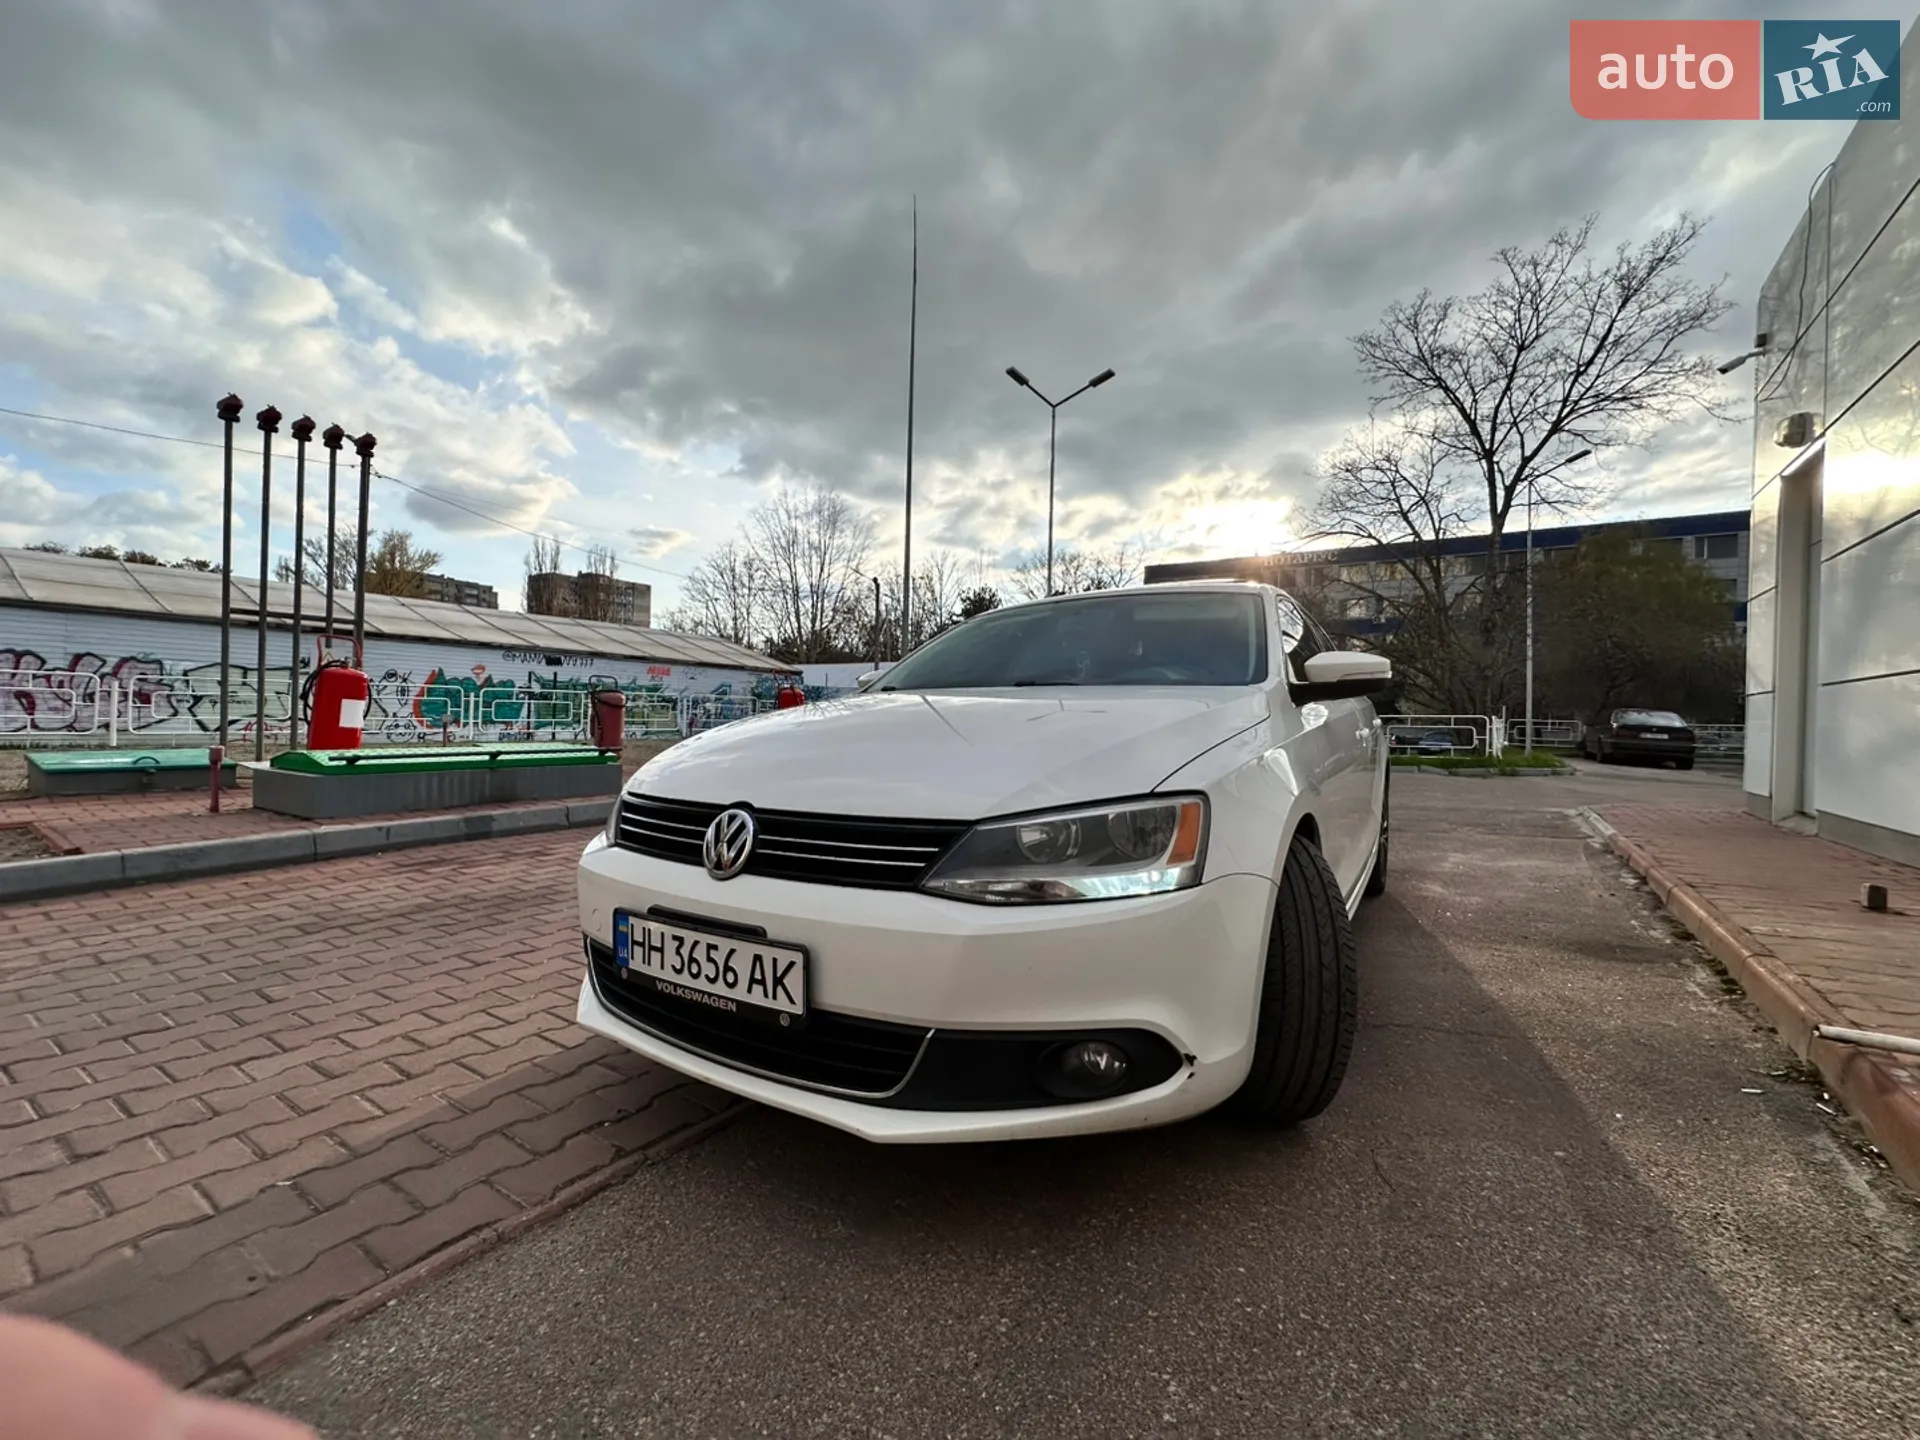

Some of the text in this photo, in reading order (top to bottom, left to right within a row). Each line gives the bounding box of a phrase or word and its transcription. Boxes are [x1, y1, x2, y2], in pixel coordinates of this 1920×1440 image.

[618, 946, 628, 958] UA
[630, 923, 797, 1005] HH 3656 AK
[656, 980, 737, 1012] VOLKSWAGEN
